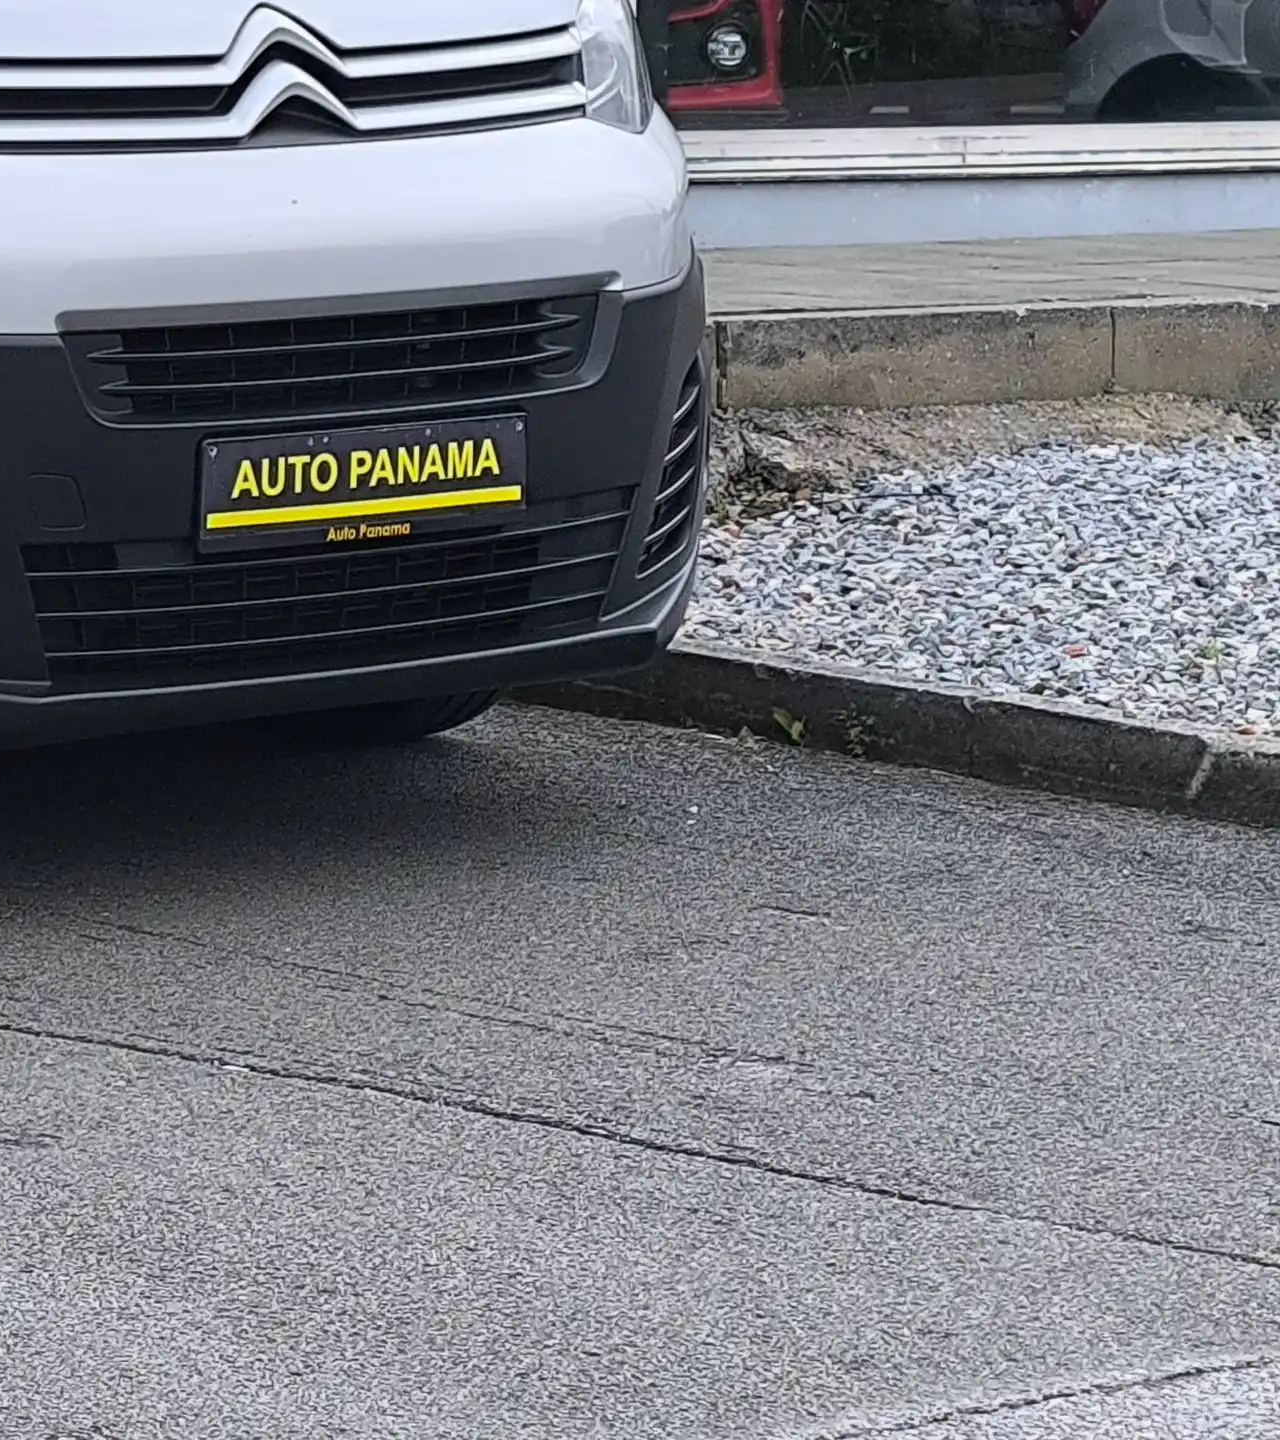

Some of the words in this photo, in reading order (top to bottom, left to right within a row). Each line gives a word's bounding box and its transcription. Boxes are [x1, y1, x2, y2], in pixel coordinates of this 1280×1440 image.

[230, 452, 339, 500] AUTO
[348, 438, 501, 490] PANAMA
[326, 526, 357, 542] Auto
[359, 522, 411, 540] Panama
